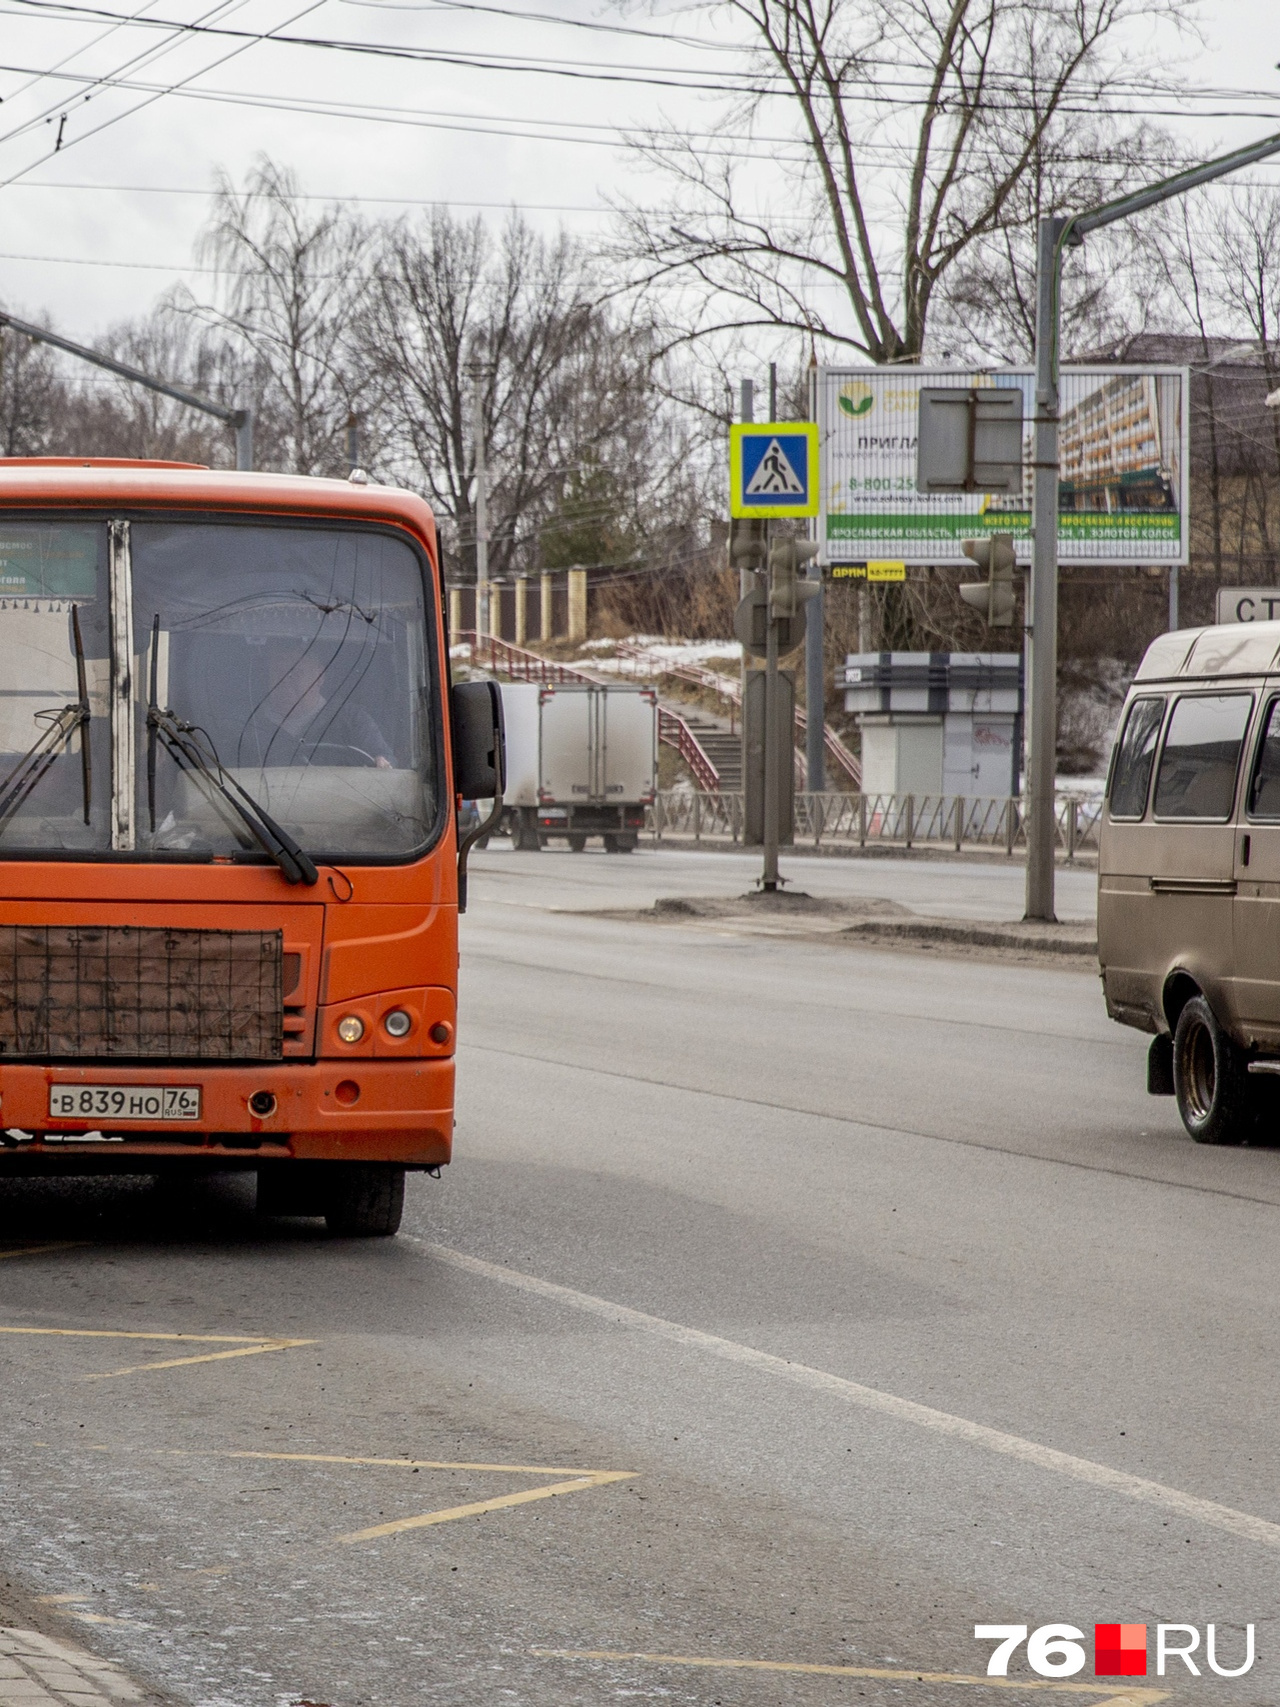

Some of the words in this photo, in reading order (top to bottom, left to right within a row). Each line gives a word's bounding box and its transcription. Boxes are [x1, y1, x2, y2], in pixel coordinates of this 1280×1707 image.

[858, 436, 918, 450] ПРИГЛА
[849, 476, 918, 491] 8-800-25
[166, 1091, 190, 1109] 76
